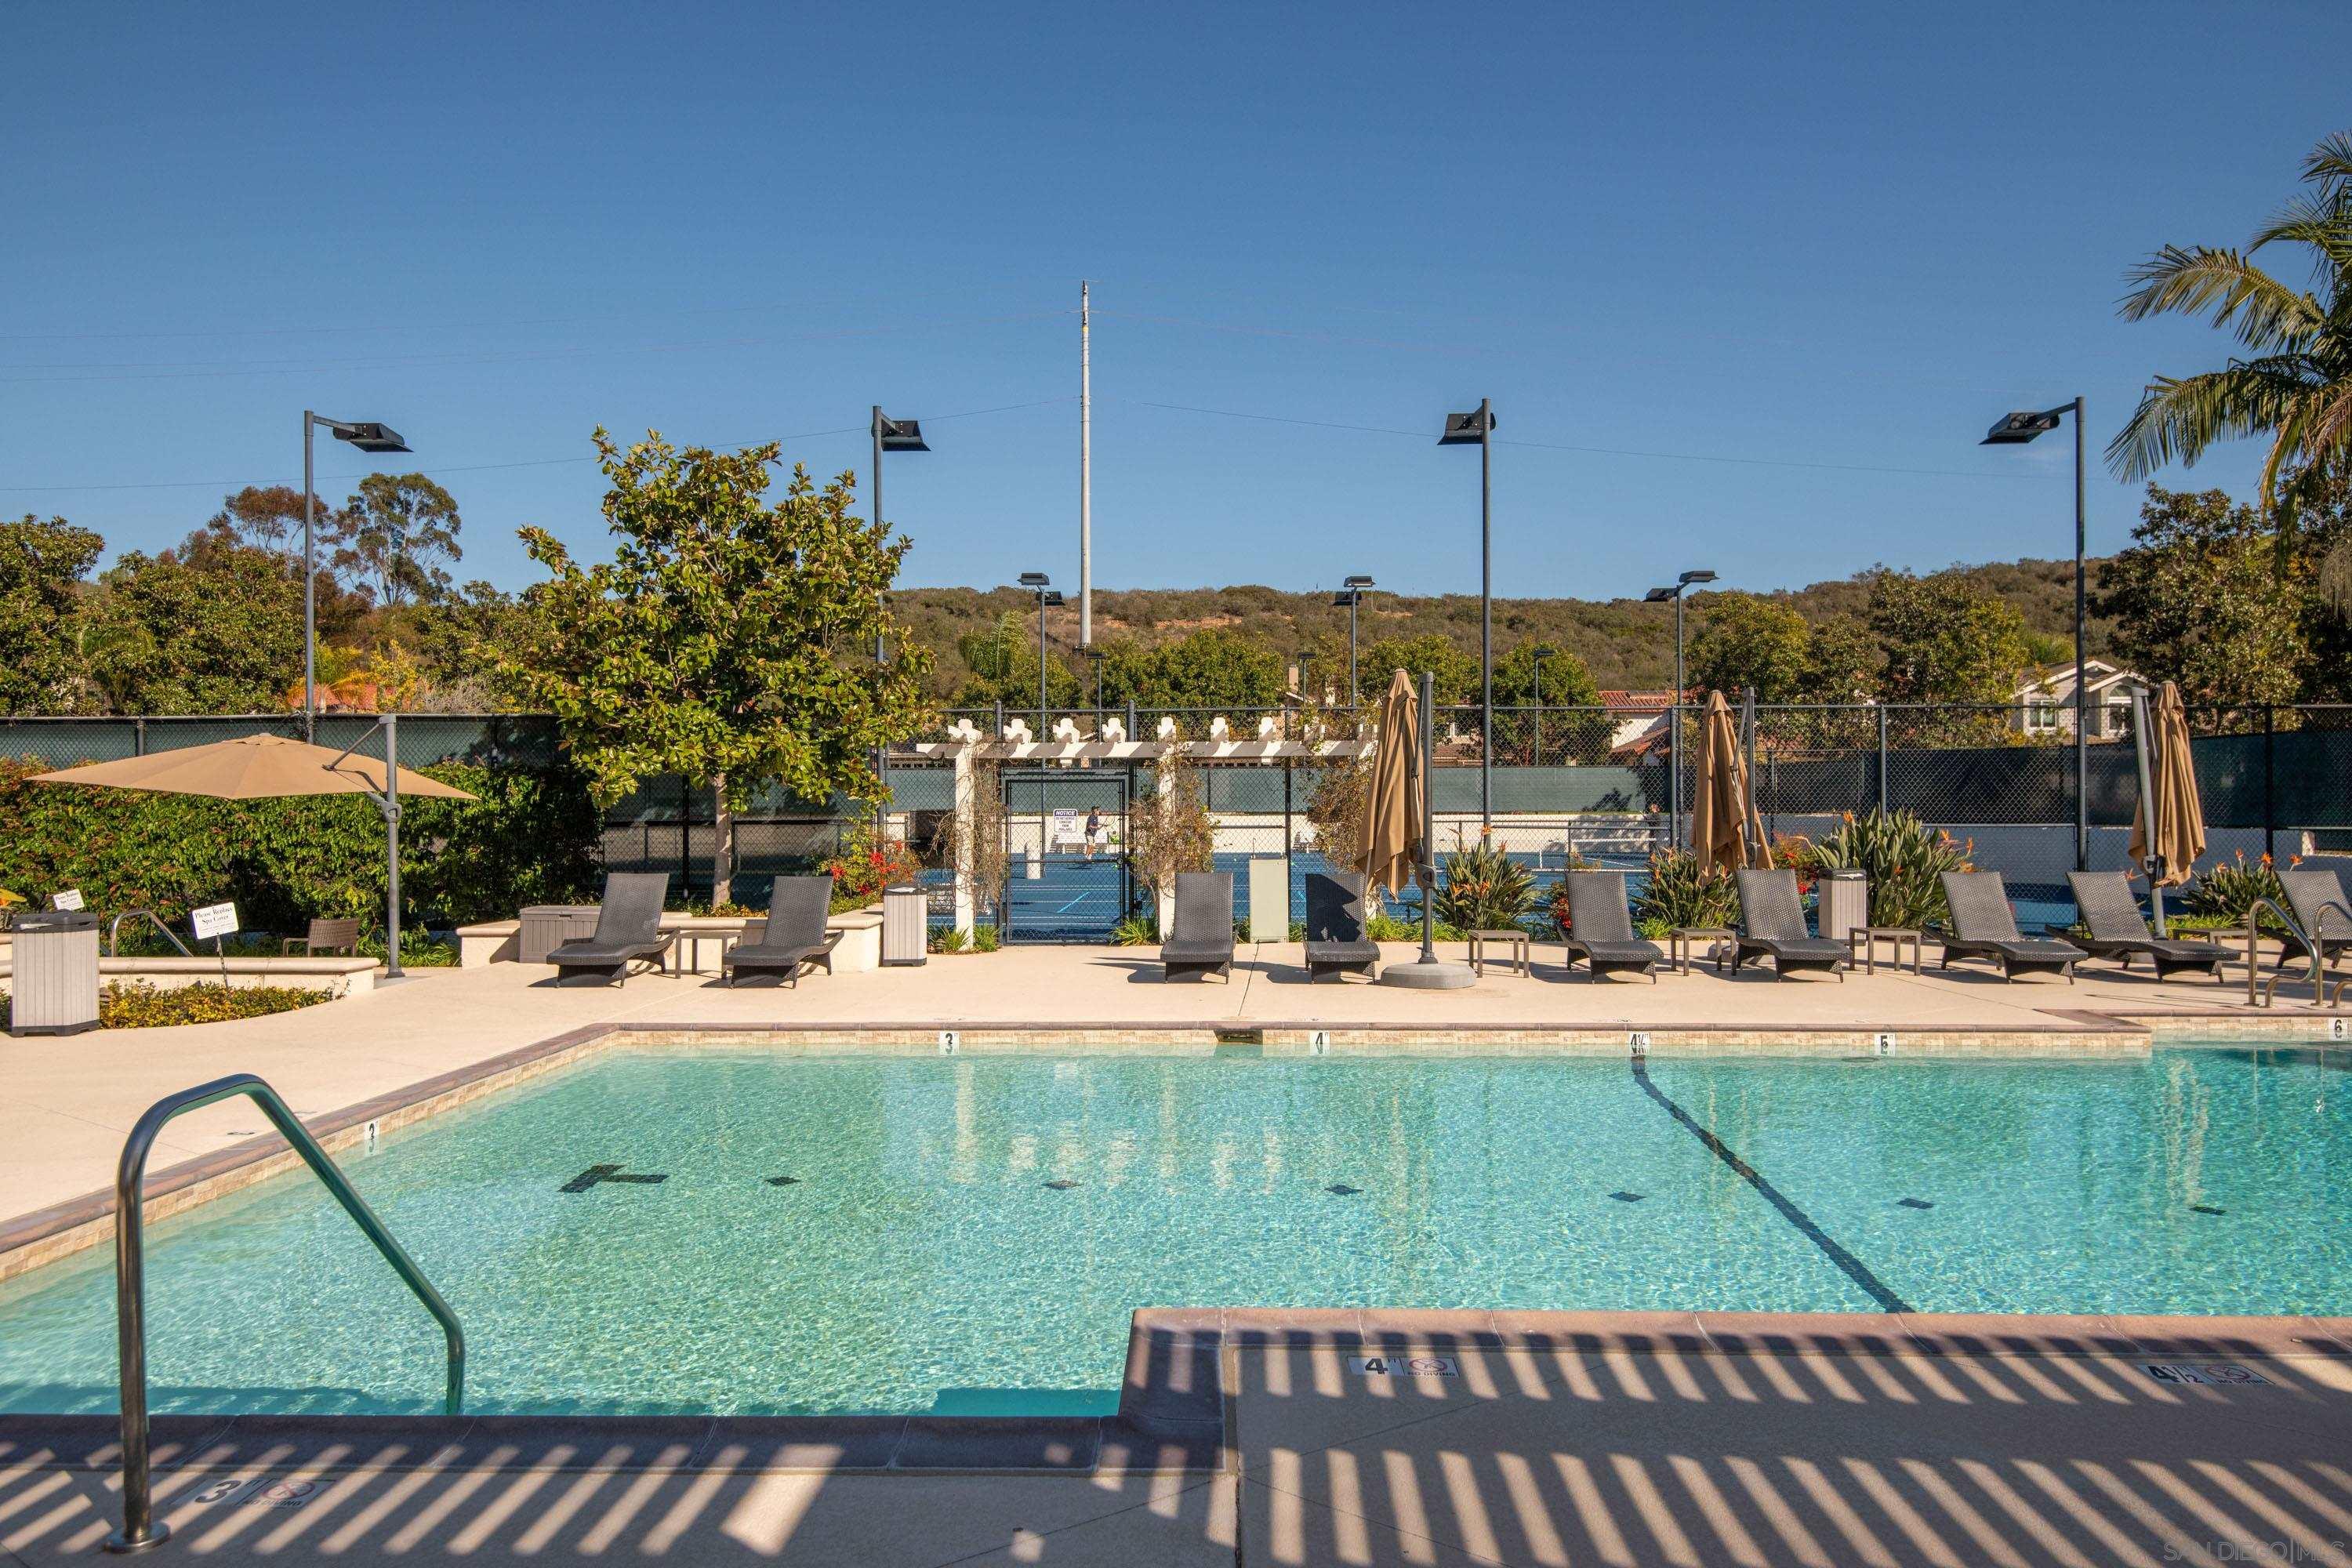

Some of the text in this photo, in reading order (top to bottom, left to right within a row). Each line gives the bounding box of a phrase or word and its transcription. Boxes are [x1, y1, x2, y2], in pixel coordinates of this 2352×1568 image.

[2335, 1019, 2342, 1032] 6
[1365, 1358, 1388, 1374] 4
[194, 1480, 241, 1503] 3
